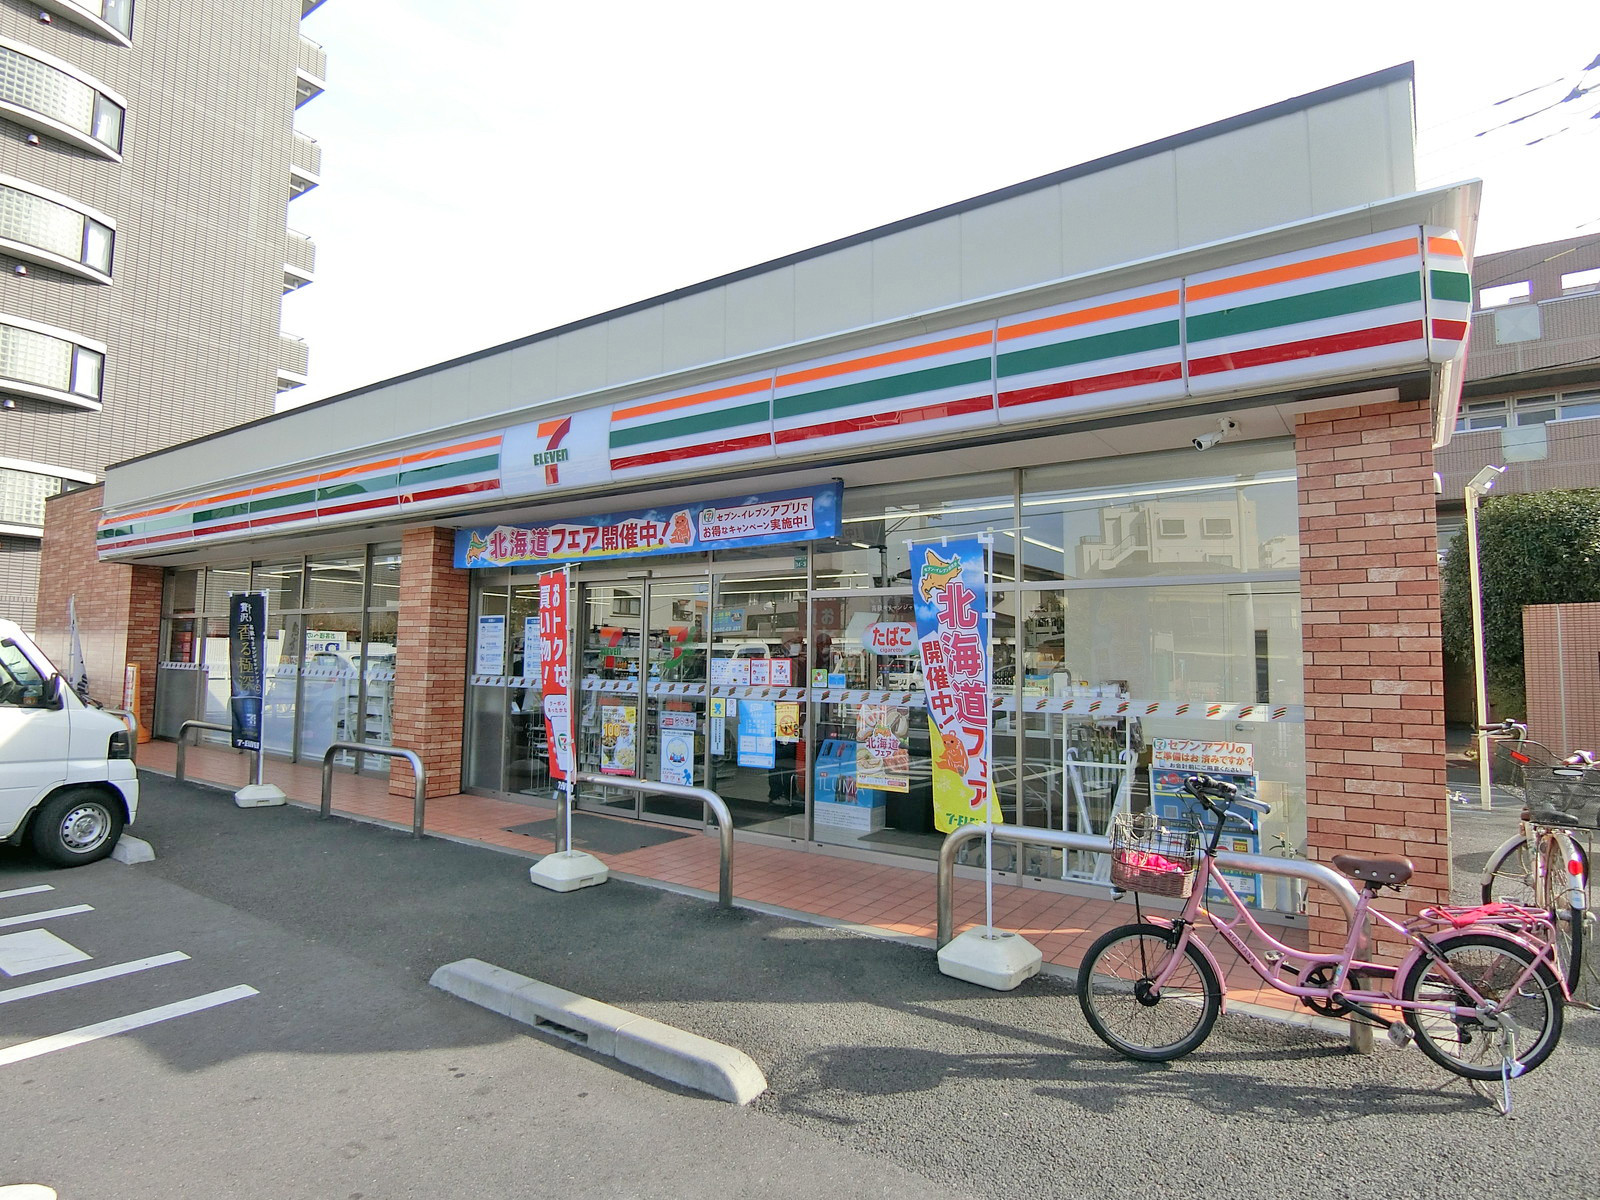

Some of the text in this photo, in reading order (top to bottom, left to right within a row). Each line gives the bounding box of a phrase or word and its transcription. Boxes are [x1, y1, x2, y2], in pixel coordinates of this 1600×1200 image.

[536, 416, 572, 486] 7
[716, 502, 808, 522] セブン-イレブンアプリで
[703, 515, 808, 539] お得なキャンペーン実施中!
[489, 520, 671, 559] 北海道フェア開催中!
[540, 584, 552, 686] 買い物!
[552, 583, 568, 688] おトクな
[872, 626, 912, 646] たばこ
[922, 640, 955, 731] 開催中!
[866, 735, 900, 751] 北海道
[874, 749, 892, 757] フェア
[1168, 739, 1246, 755] セブンアプリの
